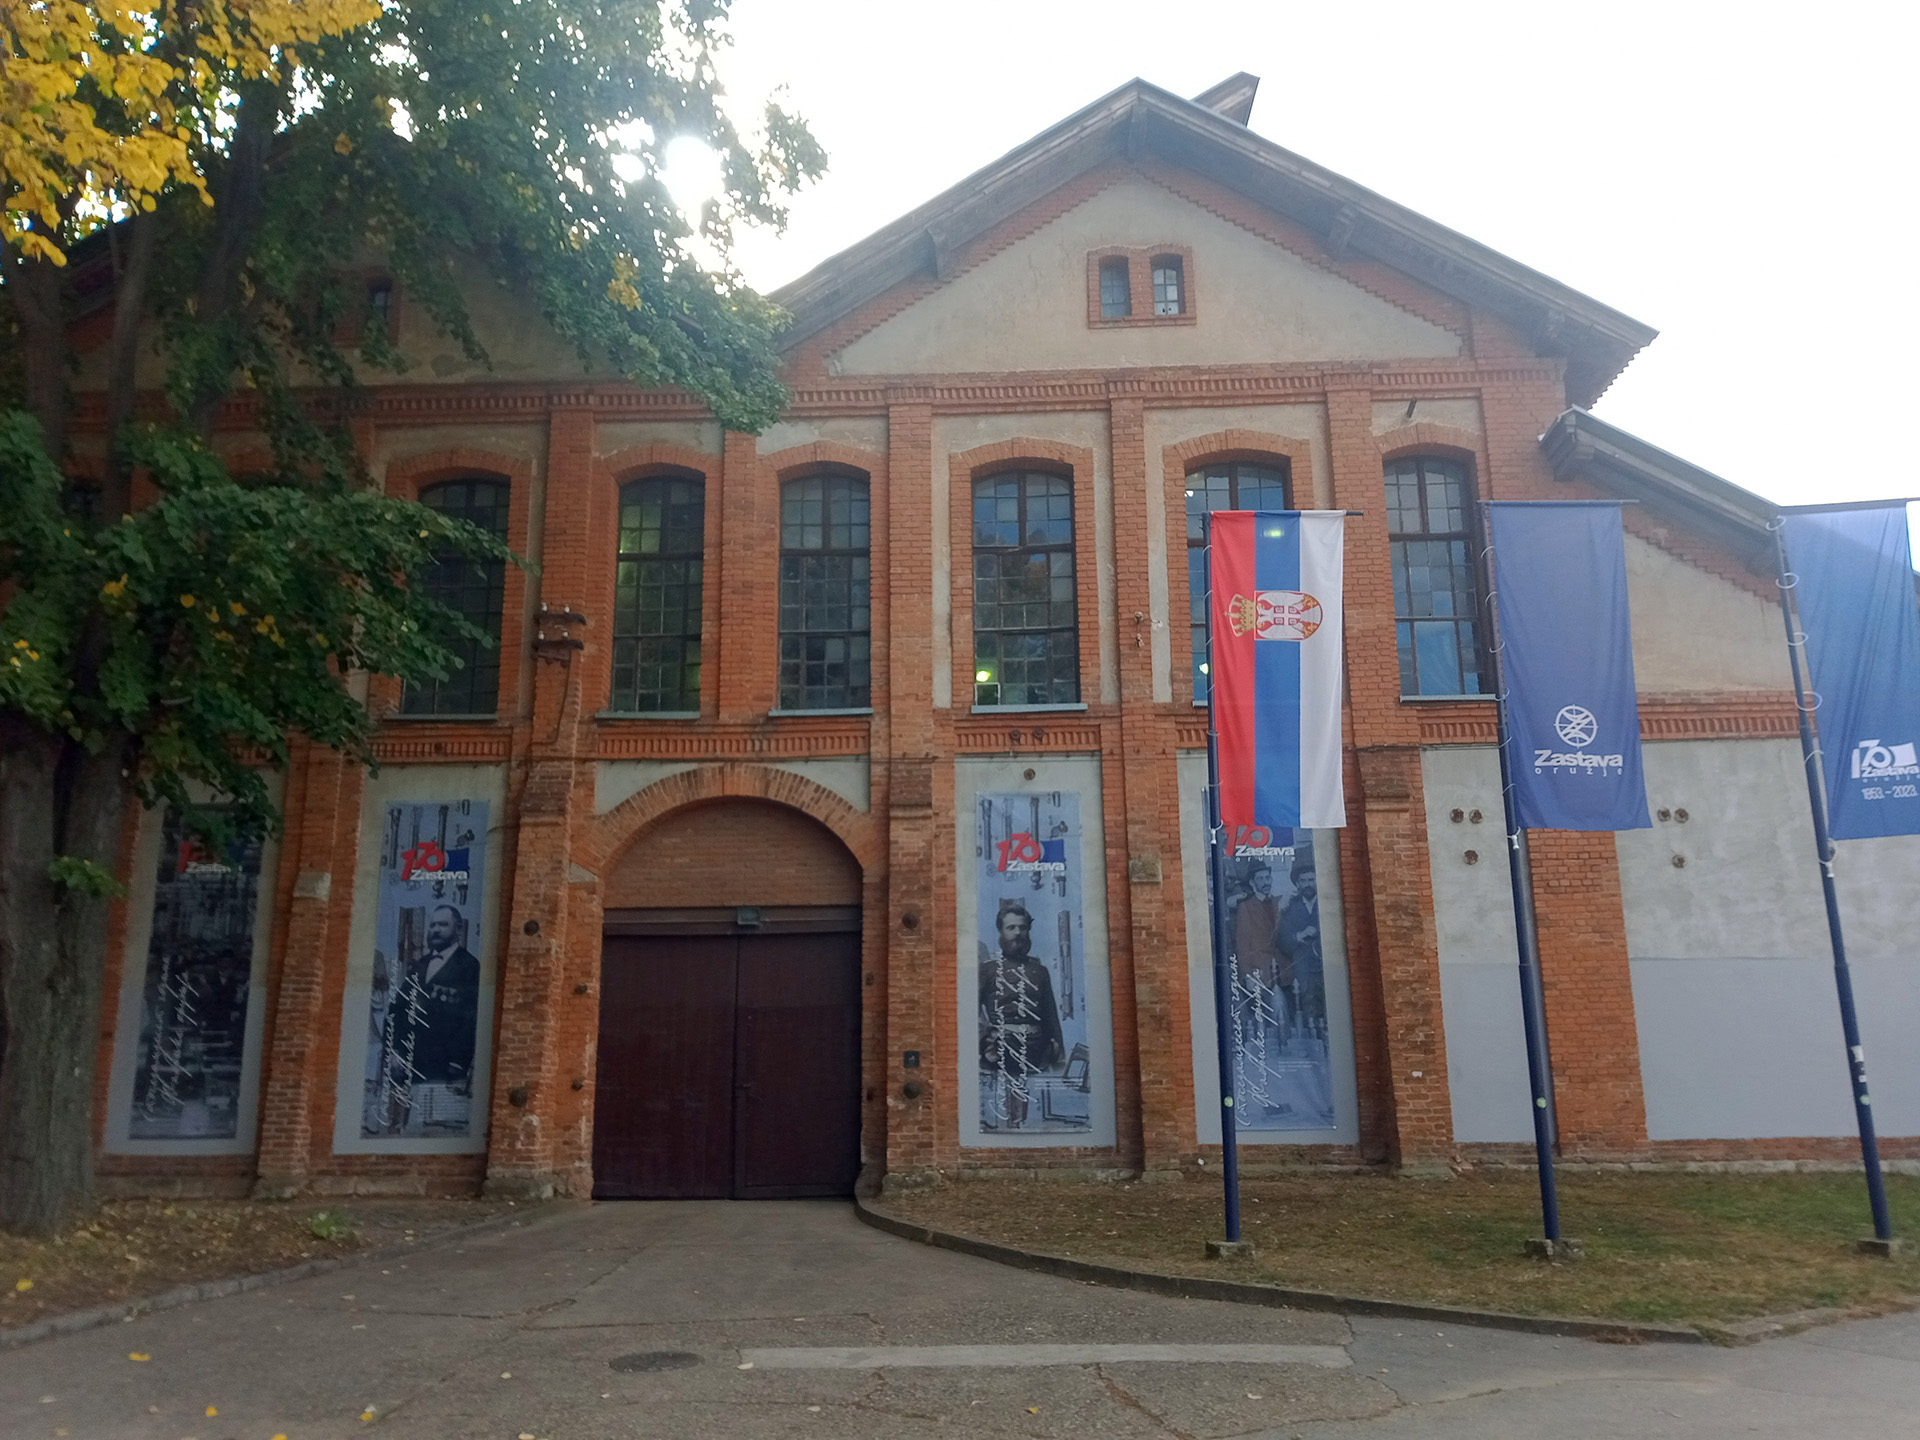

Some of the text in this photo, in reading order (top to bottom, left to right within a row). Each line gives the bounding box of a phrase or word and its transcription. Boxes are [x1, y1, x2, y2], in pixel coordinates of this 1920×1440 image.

[1534, 749, 1623, 767] Zastava
[1851, 738, 1892, 779] 170
[1861, 765, 1920, 778] Zastava
[997, 832, 1042, 872] 170
[1235, 845, 1296, 857] Zastava
[401, 841, 446, 881] 170
[1006, 861, 1066, 872] Zastava
[409, 869, 469, 881] Zastava
